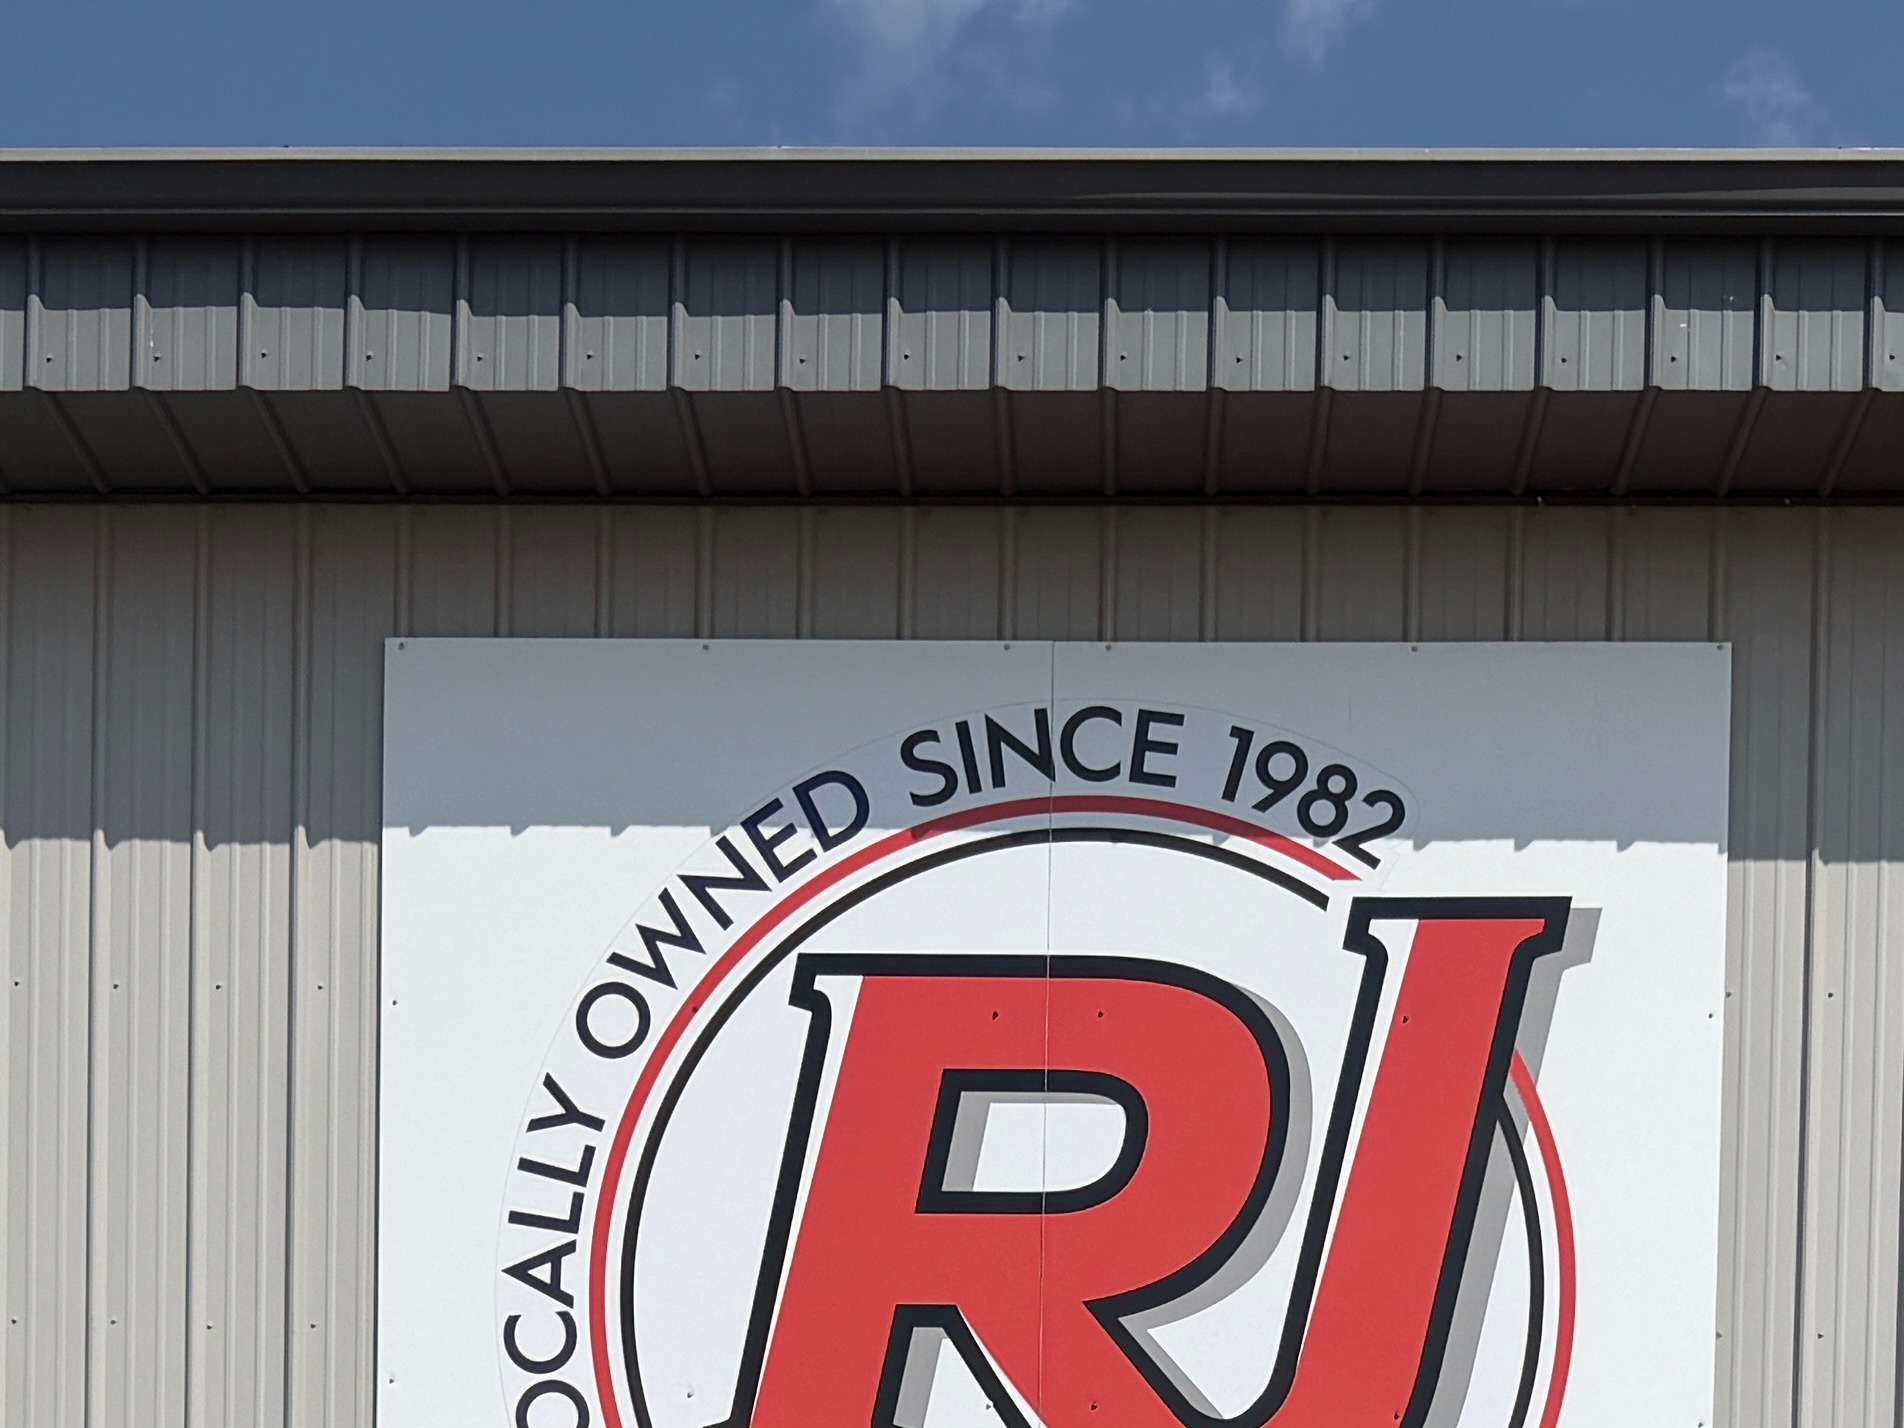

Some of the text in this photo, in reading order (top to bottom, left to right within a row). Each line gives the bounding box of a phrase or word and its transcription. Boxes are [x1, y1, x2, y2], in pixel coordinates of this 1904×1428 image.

[575, 769, 871, 1060] OWNED
[900, 705, 1186, 807] SINCE
[1222, 725, 1407, 871] 1982
